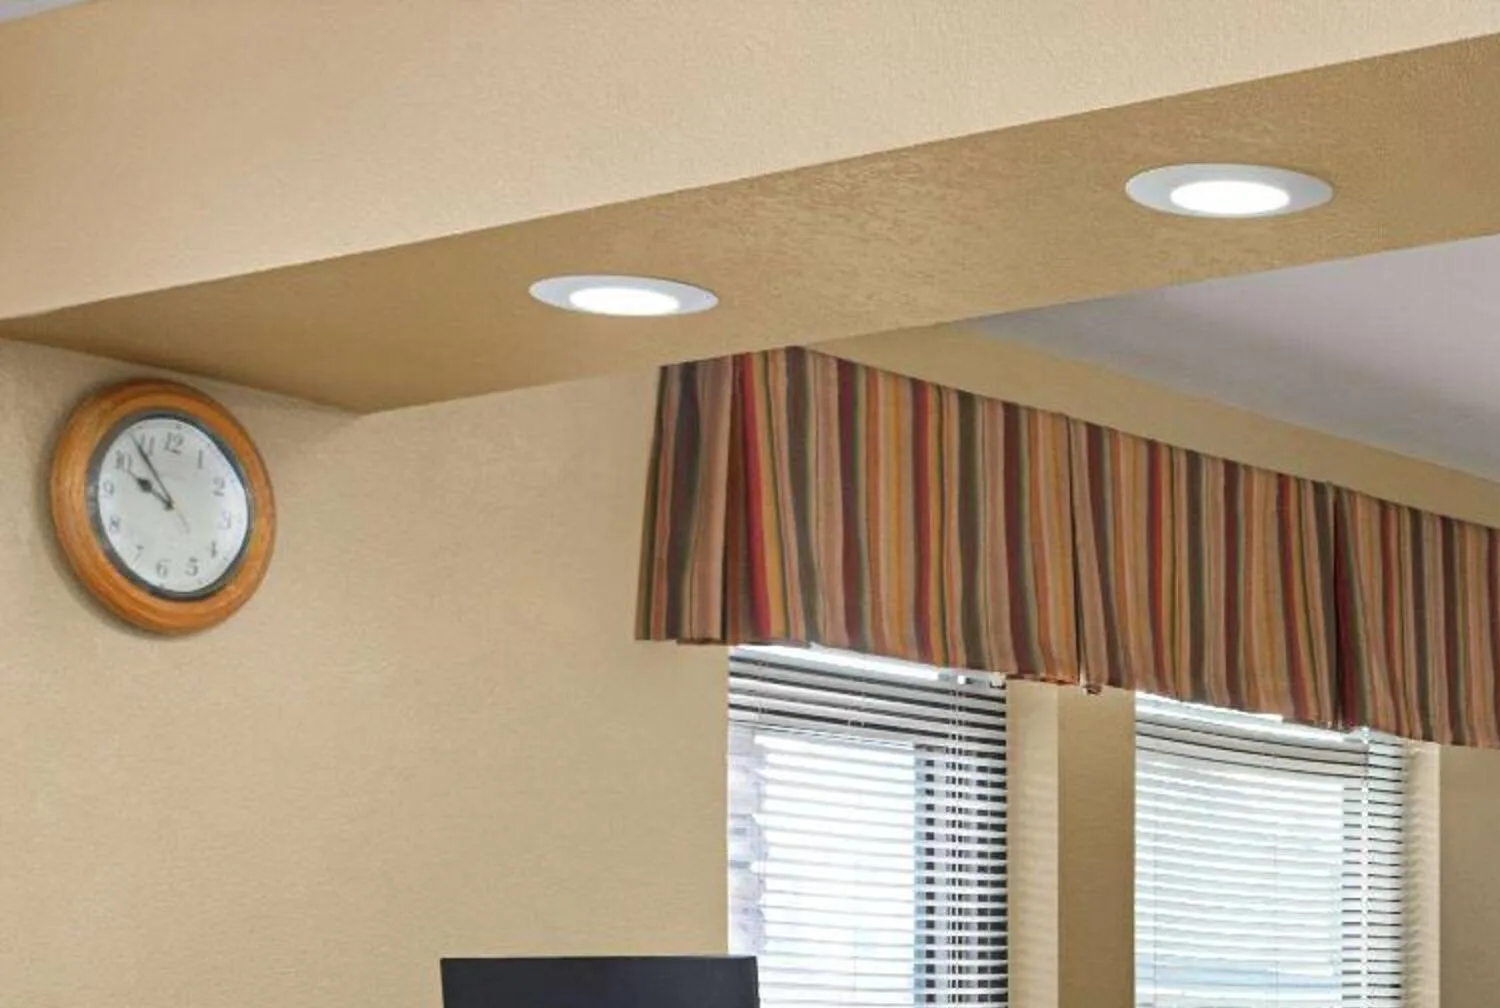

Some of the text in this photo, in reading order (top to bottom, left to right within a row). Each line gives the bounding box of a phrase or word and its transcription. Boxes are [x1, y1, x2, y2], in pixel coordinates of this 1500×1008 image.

[164, 432, 185, 454] 12
[213, 477, 226, 497] 2
[156, 558, 169, 577] 6
